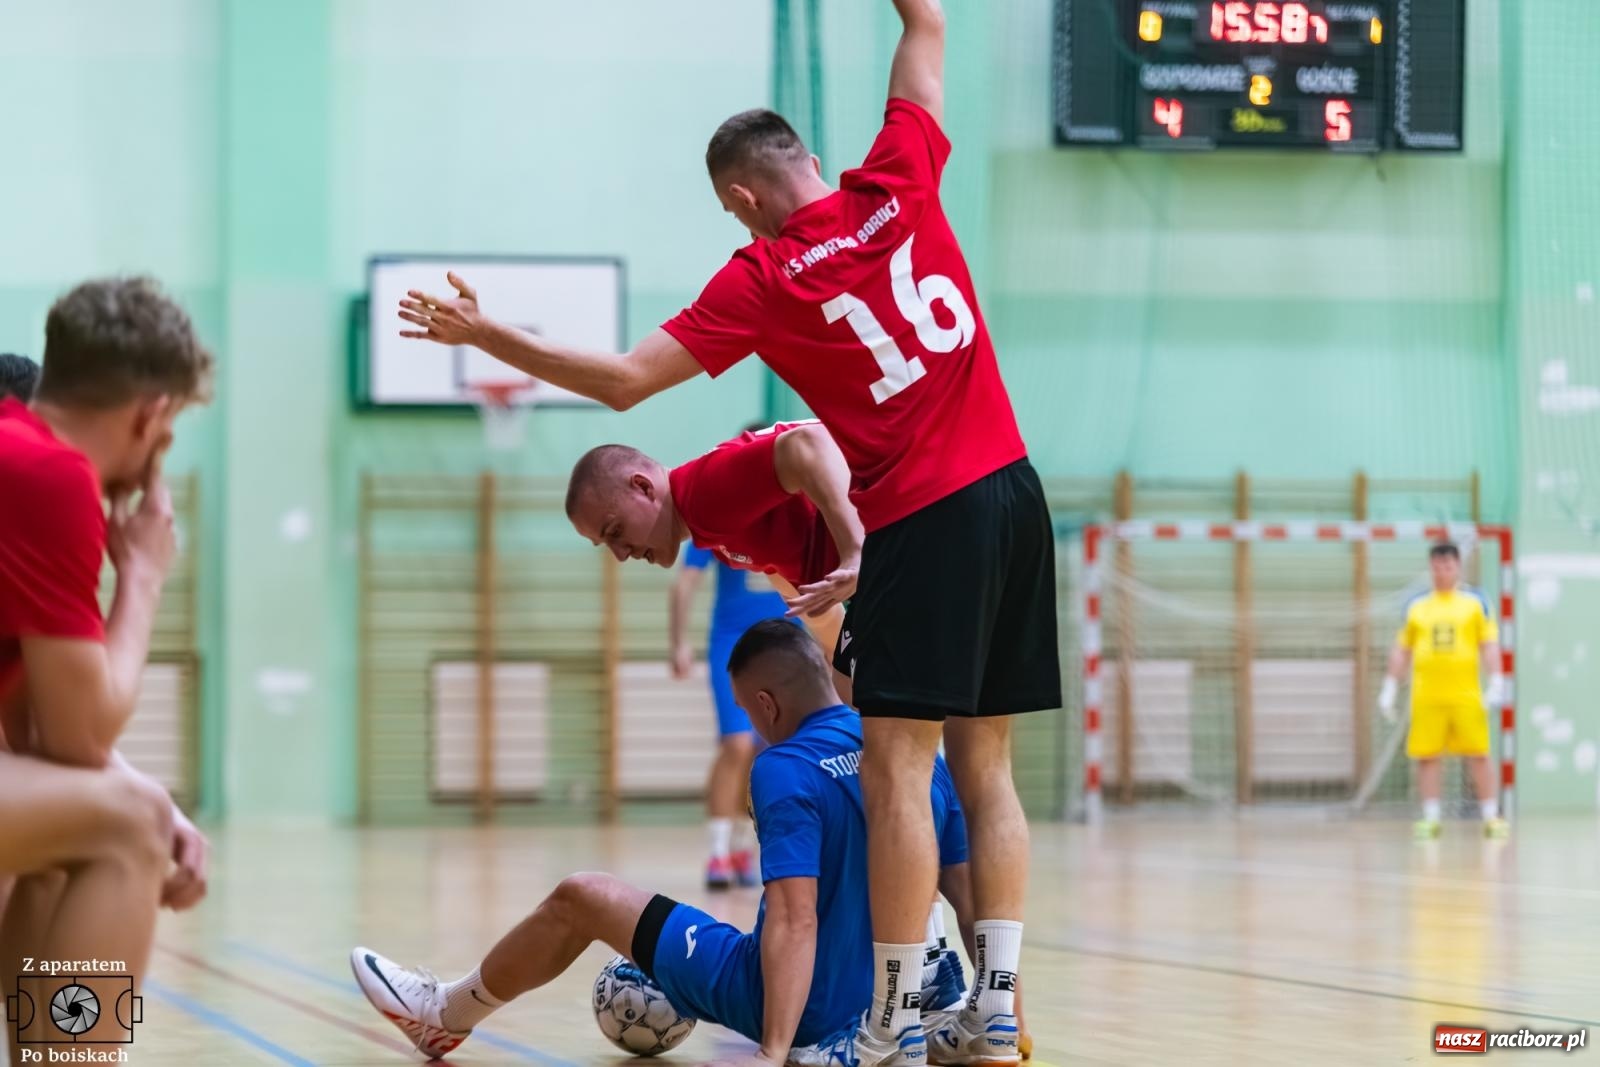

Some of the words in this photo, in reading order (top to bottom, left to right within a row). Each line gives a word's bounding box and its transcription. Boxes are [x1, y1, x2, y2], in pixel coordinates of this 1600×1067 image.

[1153, 97, 1183, 138] 4
[1324, 99, 1352, 141] 5
[821, 232, 976, 405] 16
